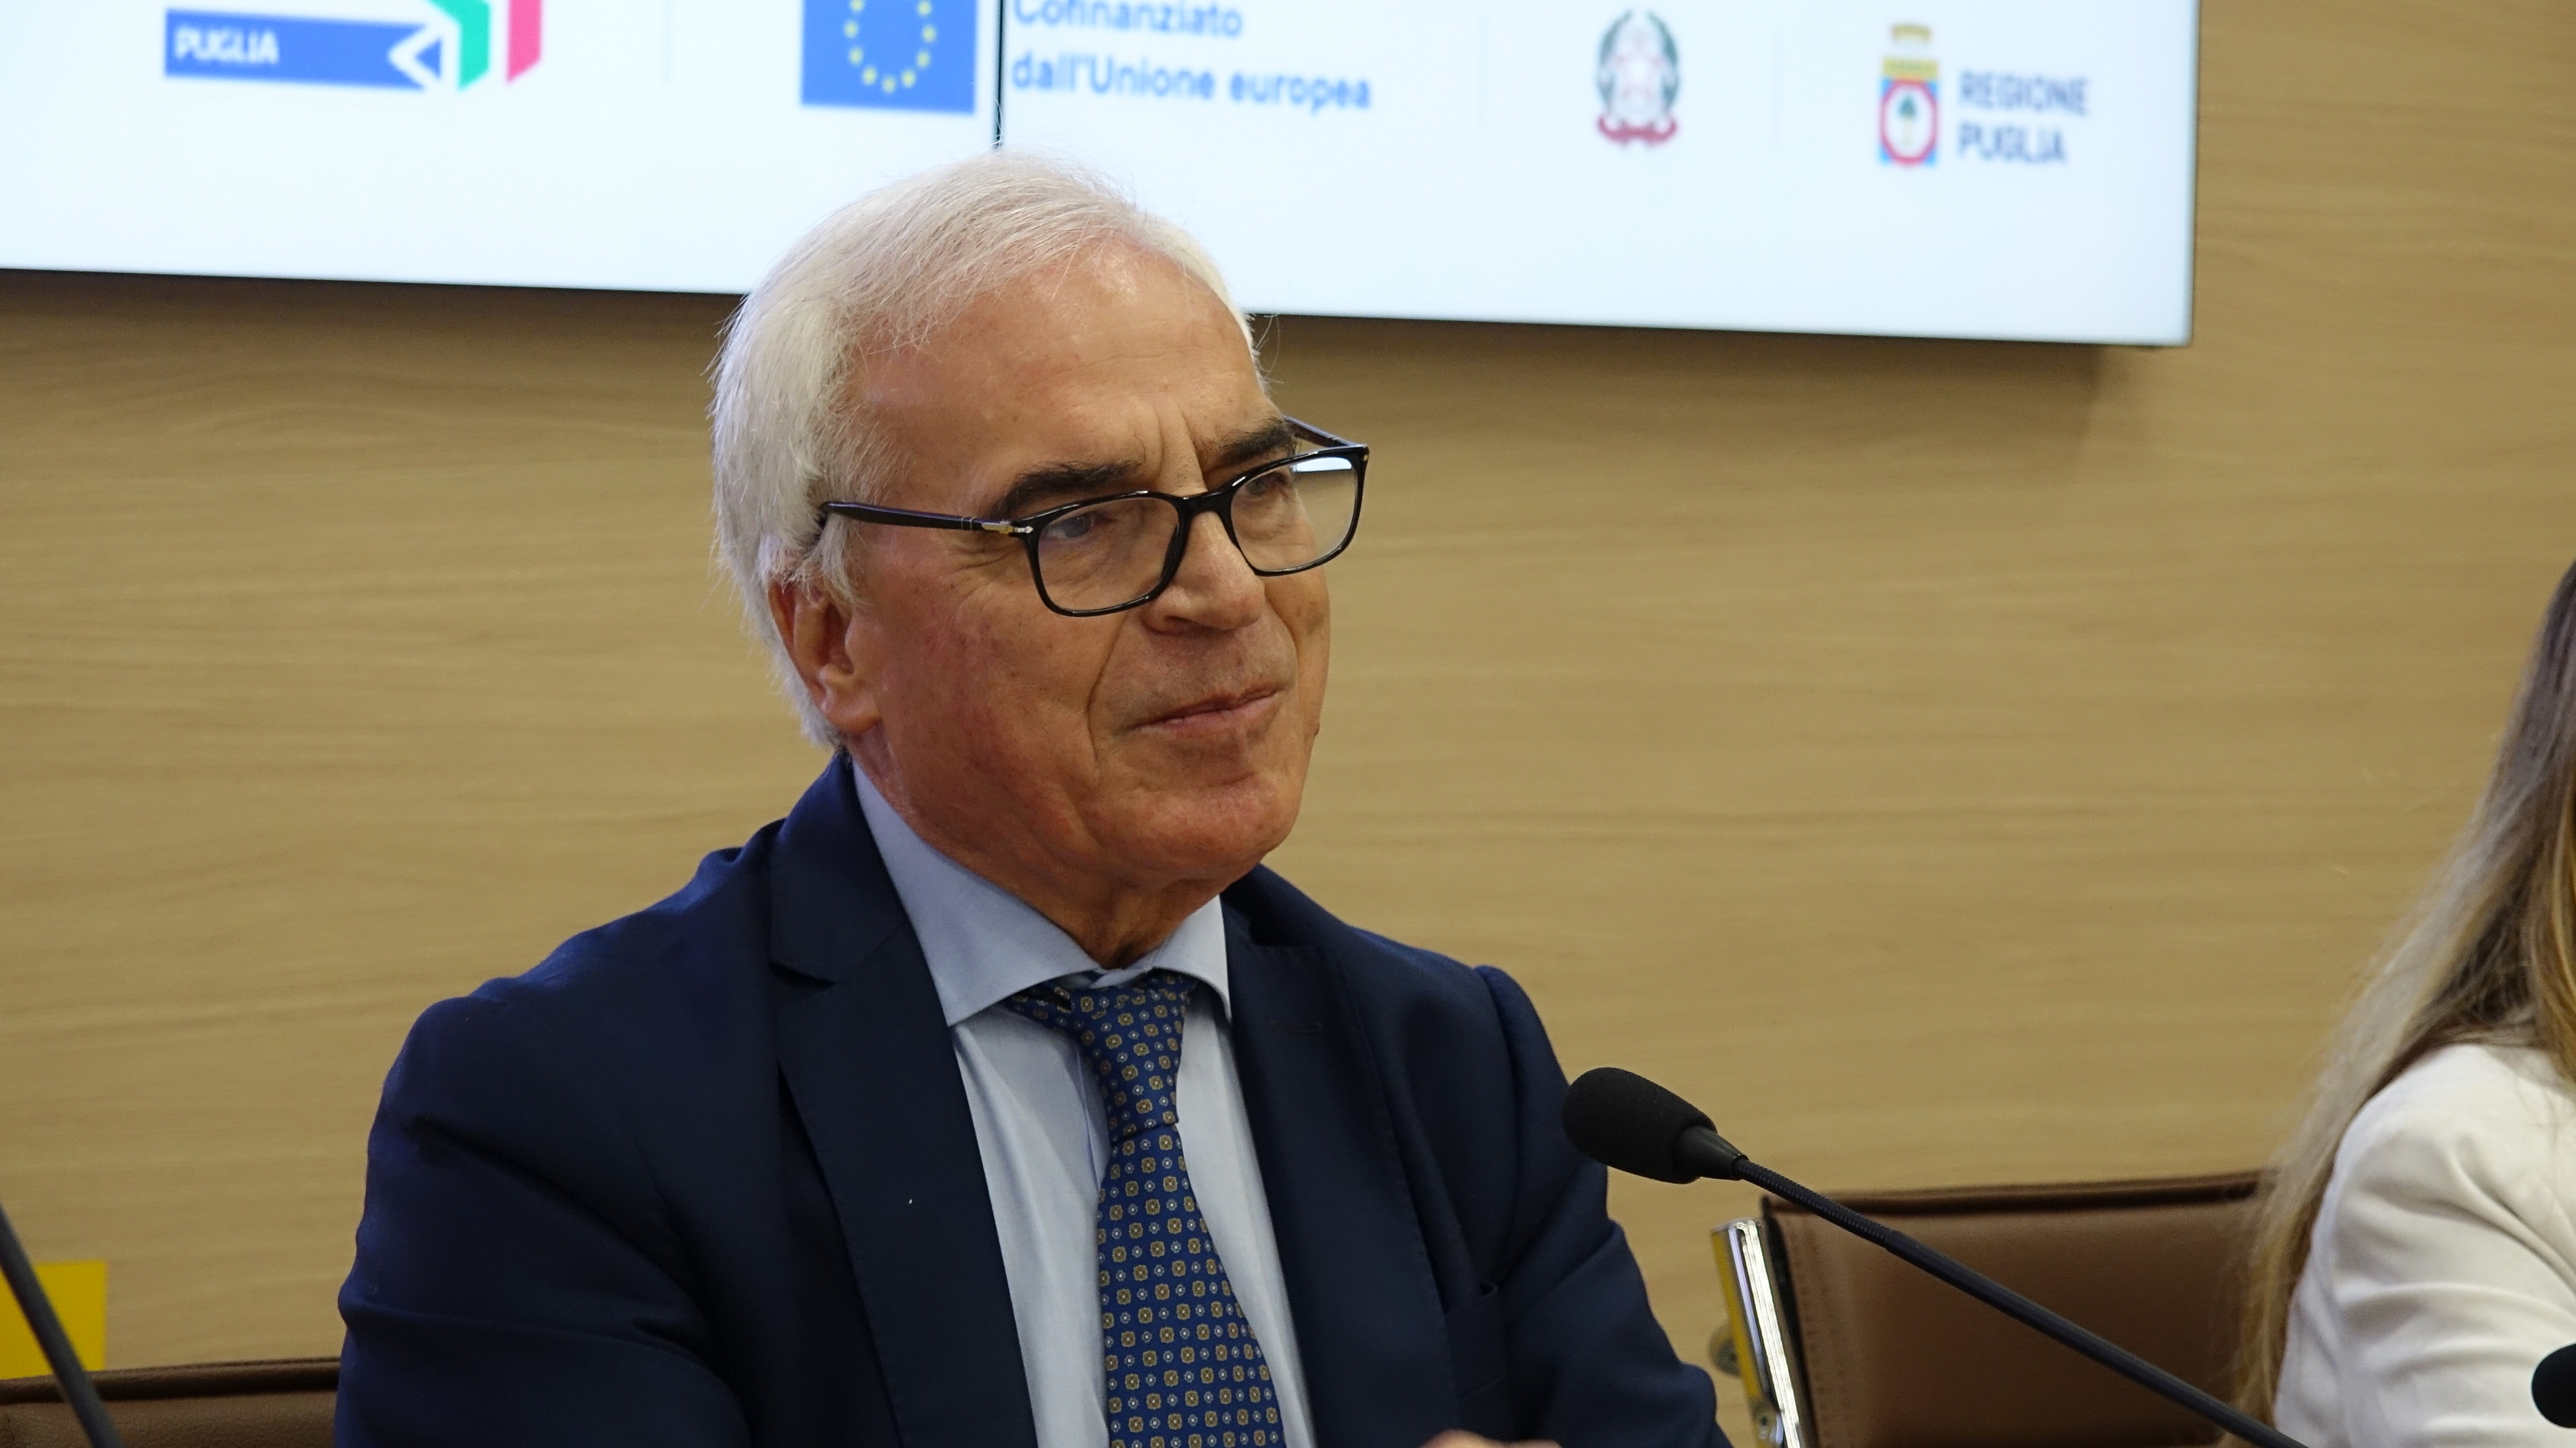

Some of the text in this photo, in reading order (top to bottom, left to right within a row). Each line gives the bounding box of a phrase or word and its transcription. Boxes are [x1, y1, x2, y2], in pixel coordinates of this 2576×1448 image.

[1013, 0, 1243, 36] Cofinanziato
[174, 27, 279, 64] PUGLIA
[1012, 52, 1372, 115] dall'Unione europea
[1959, 70, 2088, 116] REGIONE
[1959, 122, 2066, 164] PUGLIA
